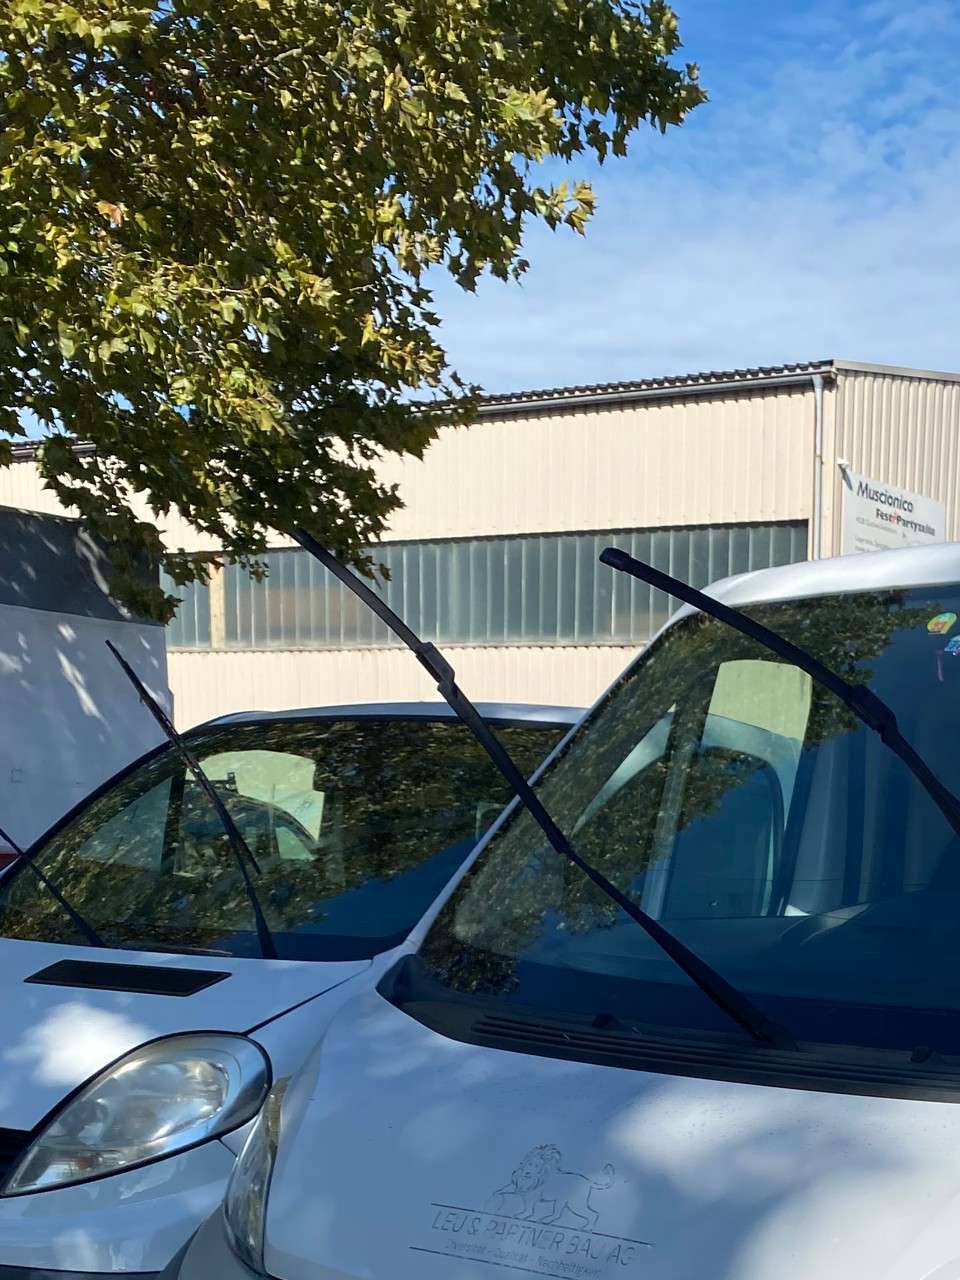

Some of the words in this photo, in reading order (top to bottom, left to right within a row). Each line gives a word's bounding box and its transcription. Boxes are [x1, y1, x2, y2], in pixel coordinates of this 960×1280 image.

[857, 481, 914, 513] Muscionico
[431, 1210, 468, 1233] LEU
[468, 1216, 482, 1236] &
[606, 1244, 636, 1266] AG
